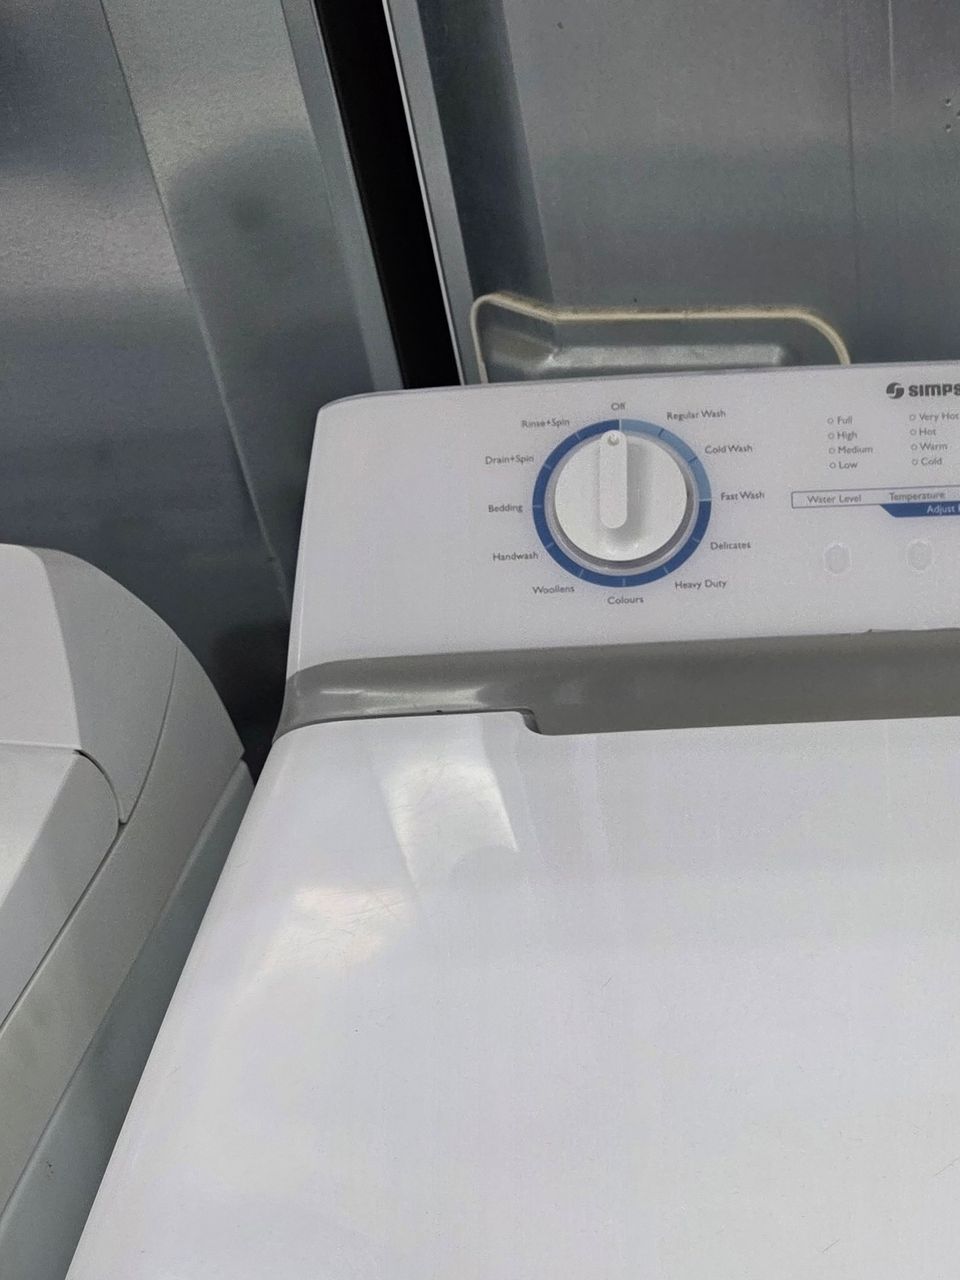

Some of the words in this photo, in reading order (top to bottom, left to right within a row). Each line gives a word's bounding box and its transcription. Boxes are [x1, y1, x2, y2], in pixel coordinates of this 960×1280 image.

[611, 403, 626, 411] Off
[666, 411, 699, 421] Regular
[701, 410, 726, 419] Wash
[837, 416, 853, 425] Full
[919, 412, 939, 423] Very
[942, 412, 959, 420] Hot
[522, 418, 570, 429] Rinse+Spin
[838, 431, 858, 441] High
[919, 428, 936, 436] Hot
[704, 445, 726, 454] Cold
[727, 444, 753, 453] Wash
[838, 445, 873, 454] Medium
[920, 442, 948, 451] Warm
[485, 455, 534, 465] Drain+Spin
[839, 460, 858, 469] Low
[921, 456, 943, 465] Cold
[721, 492, 739, 501] Fast
[740, 491, 765, 500] Wash
[807, 495, 835, 504] Water
[839, 494, 862, 502] Level
[889, 491, 945, 502] Temperature
[488, 503, 523, 513] Bedding
[926, 503, 955, 514] Adjust
[710, 541, 751, 551] Delicates
[493, 552, 539, 561] Handwash
[533, 584, 575, 595] Woollens
[675, 580, 702, 591] Heavy
[704, 579, 727, 590] Duty
[607, 596, 644, 605] Colours
